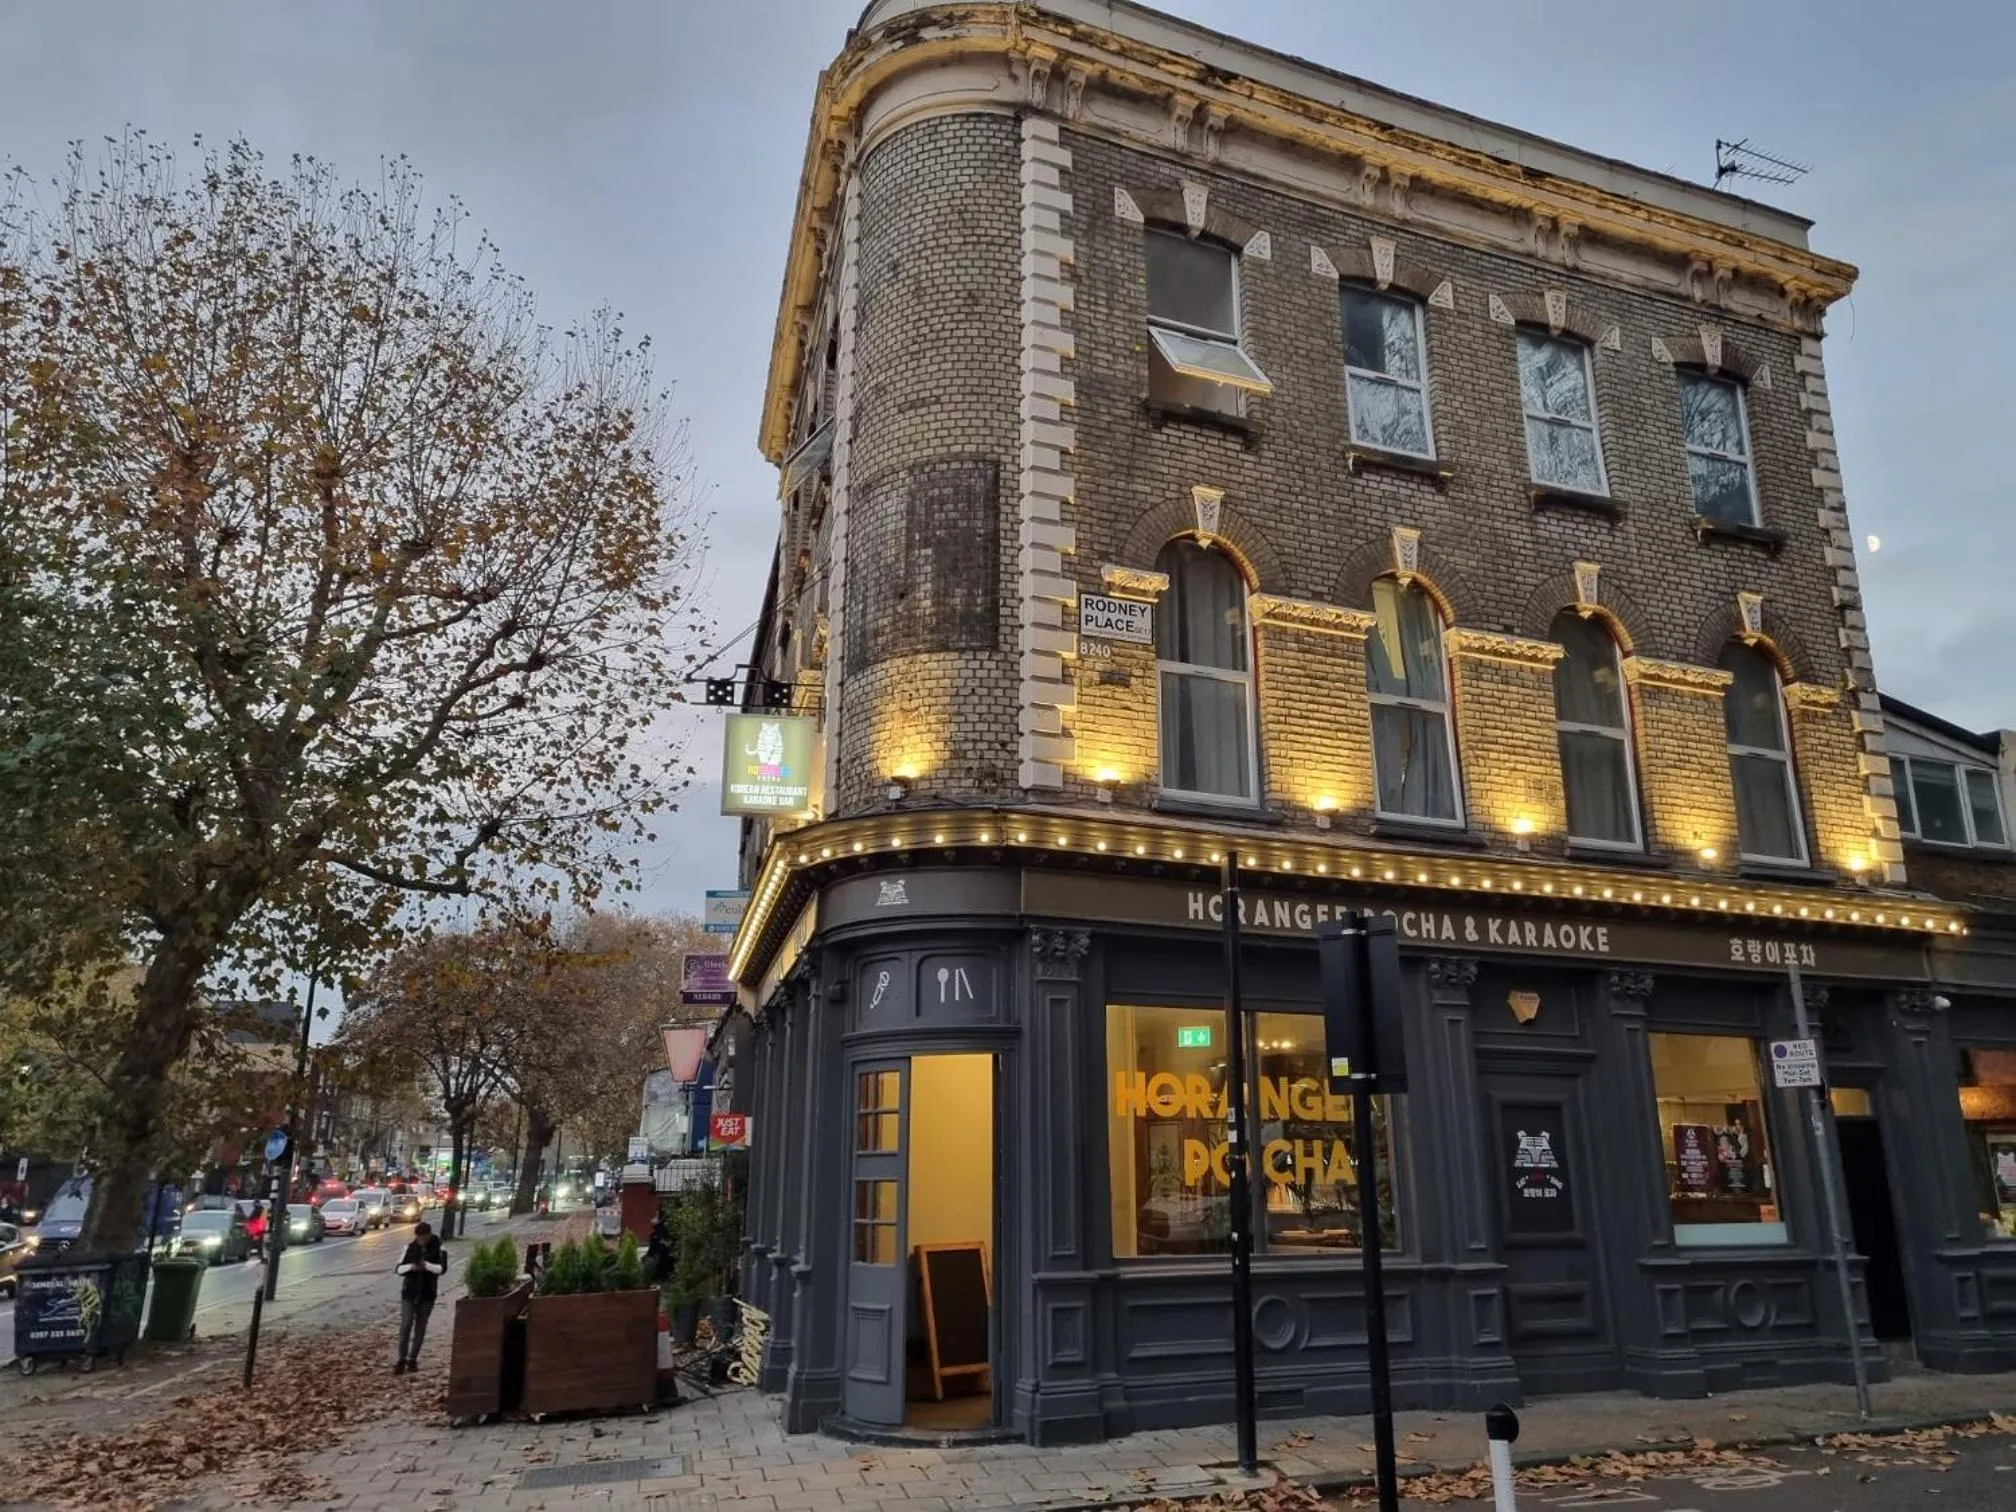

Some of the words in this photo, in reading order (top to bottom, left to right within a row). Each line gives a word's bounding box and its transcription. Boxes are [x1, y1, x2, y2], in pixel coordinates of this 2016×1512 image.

[1085, 598, 1147, 618] RODNEY
[1085, 614, 1135, 632] PLACE
[731, 784, 760, 794] KOREAN
[761, 785, 807, 796] RESTAURANT
[743, 795, 778, 805] KARAOKE
[779, 797, 794, 806] BAR
[1464, 916, 1479, 942] &
[1488, 918, 1610, 952] KARAOKE
[1729, 938, 1816, 967] 호랑이포차
[716, 1118, 740, 1128] JUST
[720, 1127, 740, 1136] EAT
